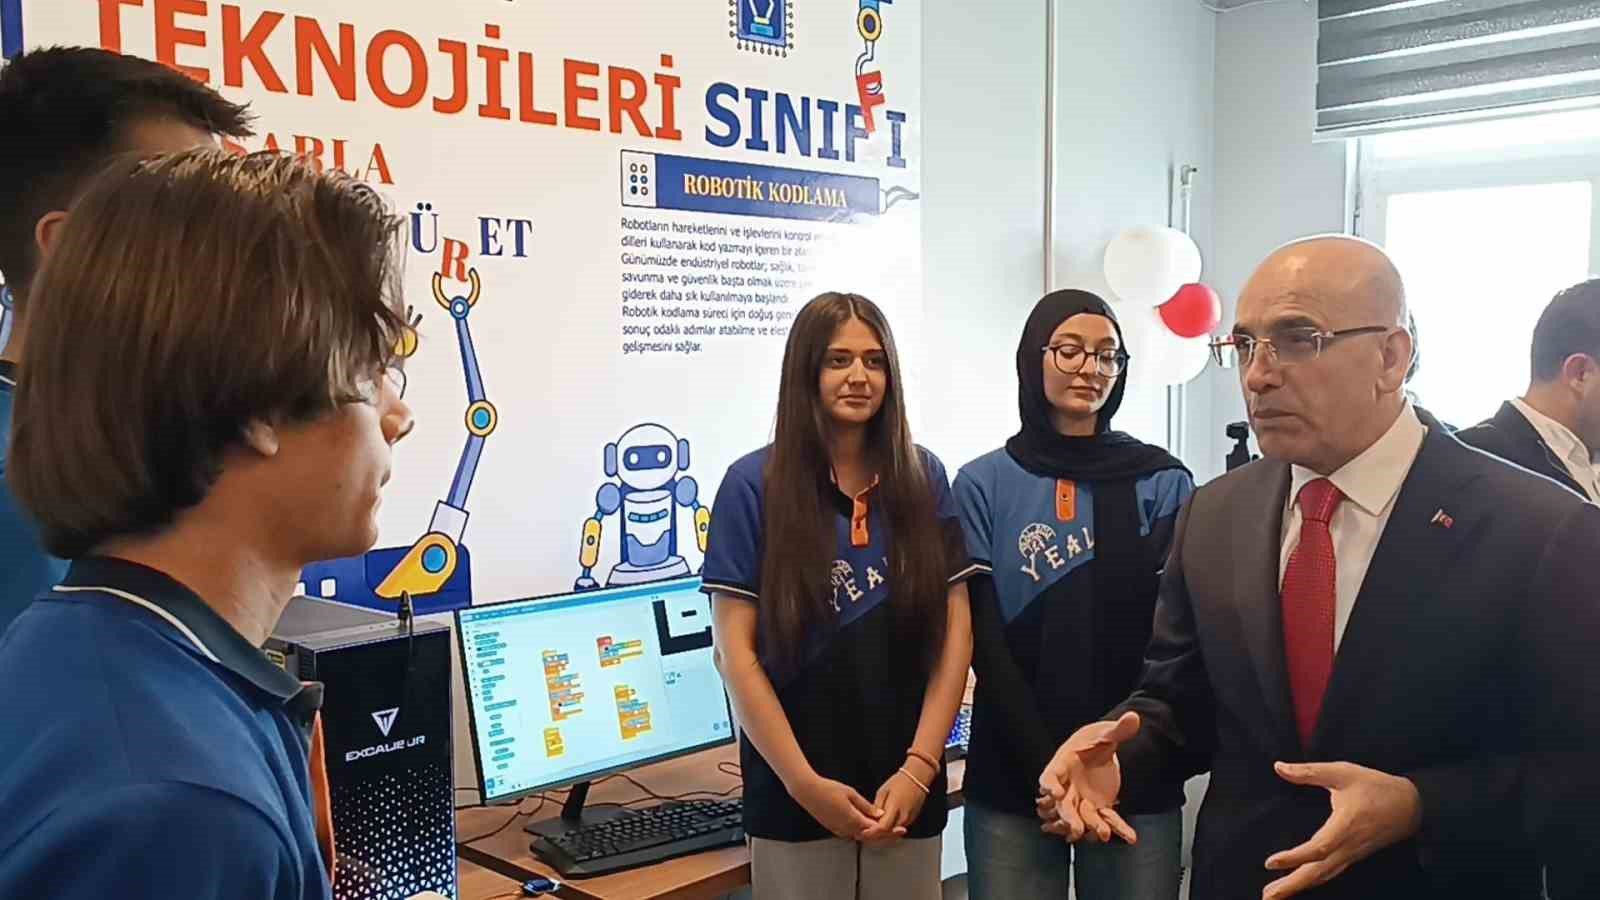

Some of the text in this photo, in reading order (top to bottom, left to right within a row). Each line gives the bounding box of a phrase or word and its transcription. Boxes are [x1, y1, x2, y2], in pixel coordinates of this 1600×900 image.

[683, 174, 848, 208] ROBOTİK KODLAMA
[730, 227, 741, 237] ve
[700, 239, 716, 252] kod
[621, 252, 678, 266] Günümüzde
[622, 272, 665, 284] savunma
[667, 273, 680, 285] ve
[622, 288, 657, 302] giderek
[659, 289, 683, 302] daha
[622, 305, 658, 319] Robotik
[661, 306, 700, 319] kodlama
[622, 324, 651, 338] sonuç
